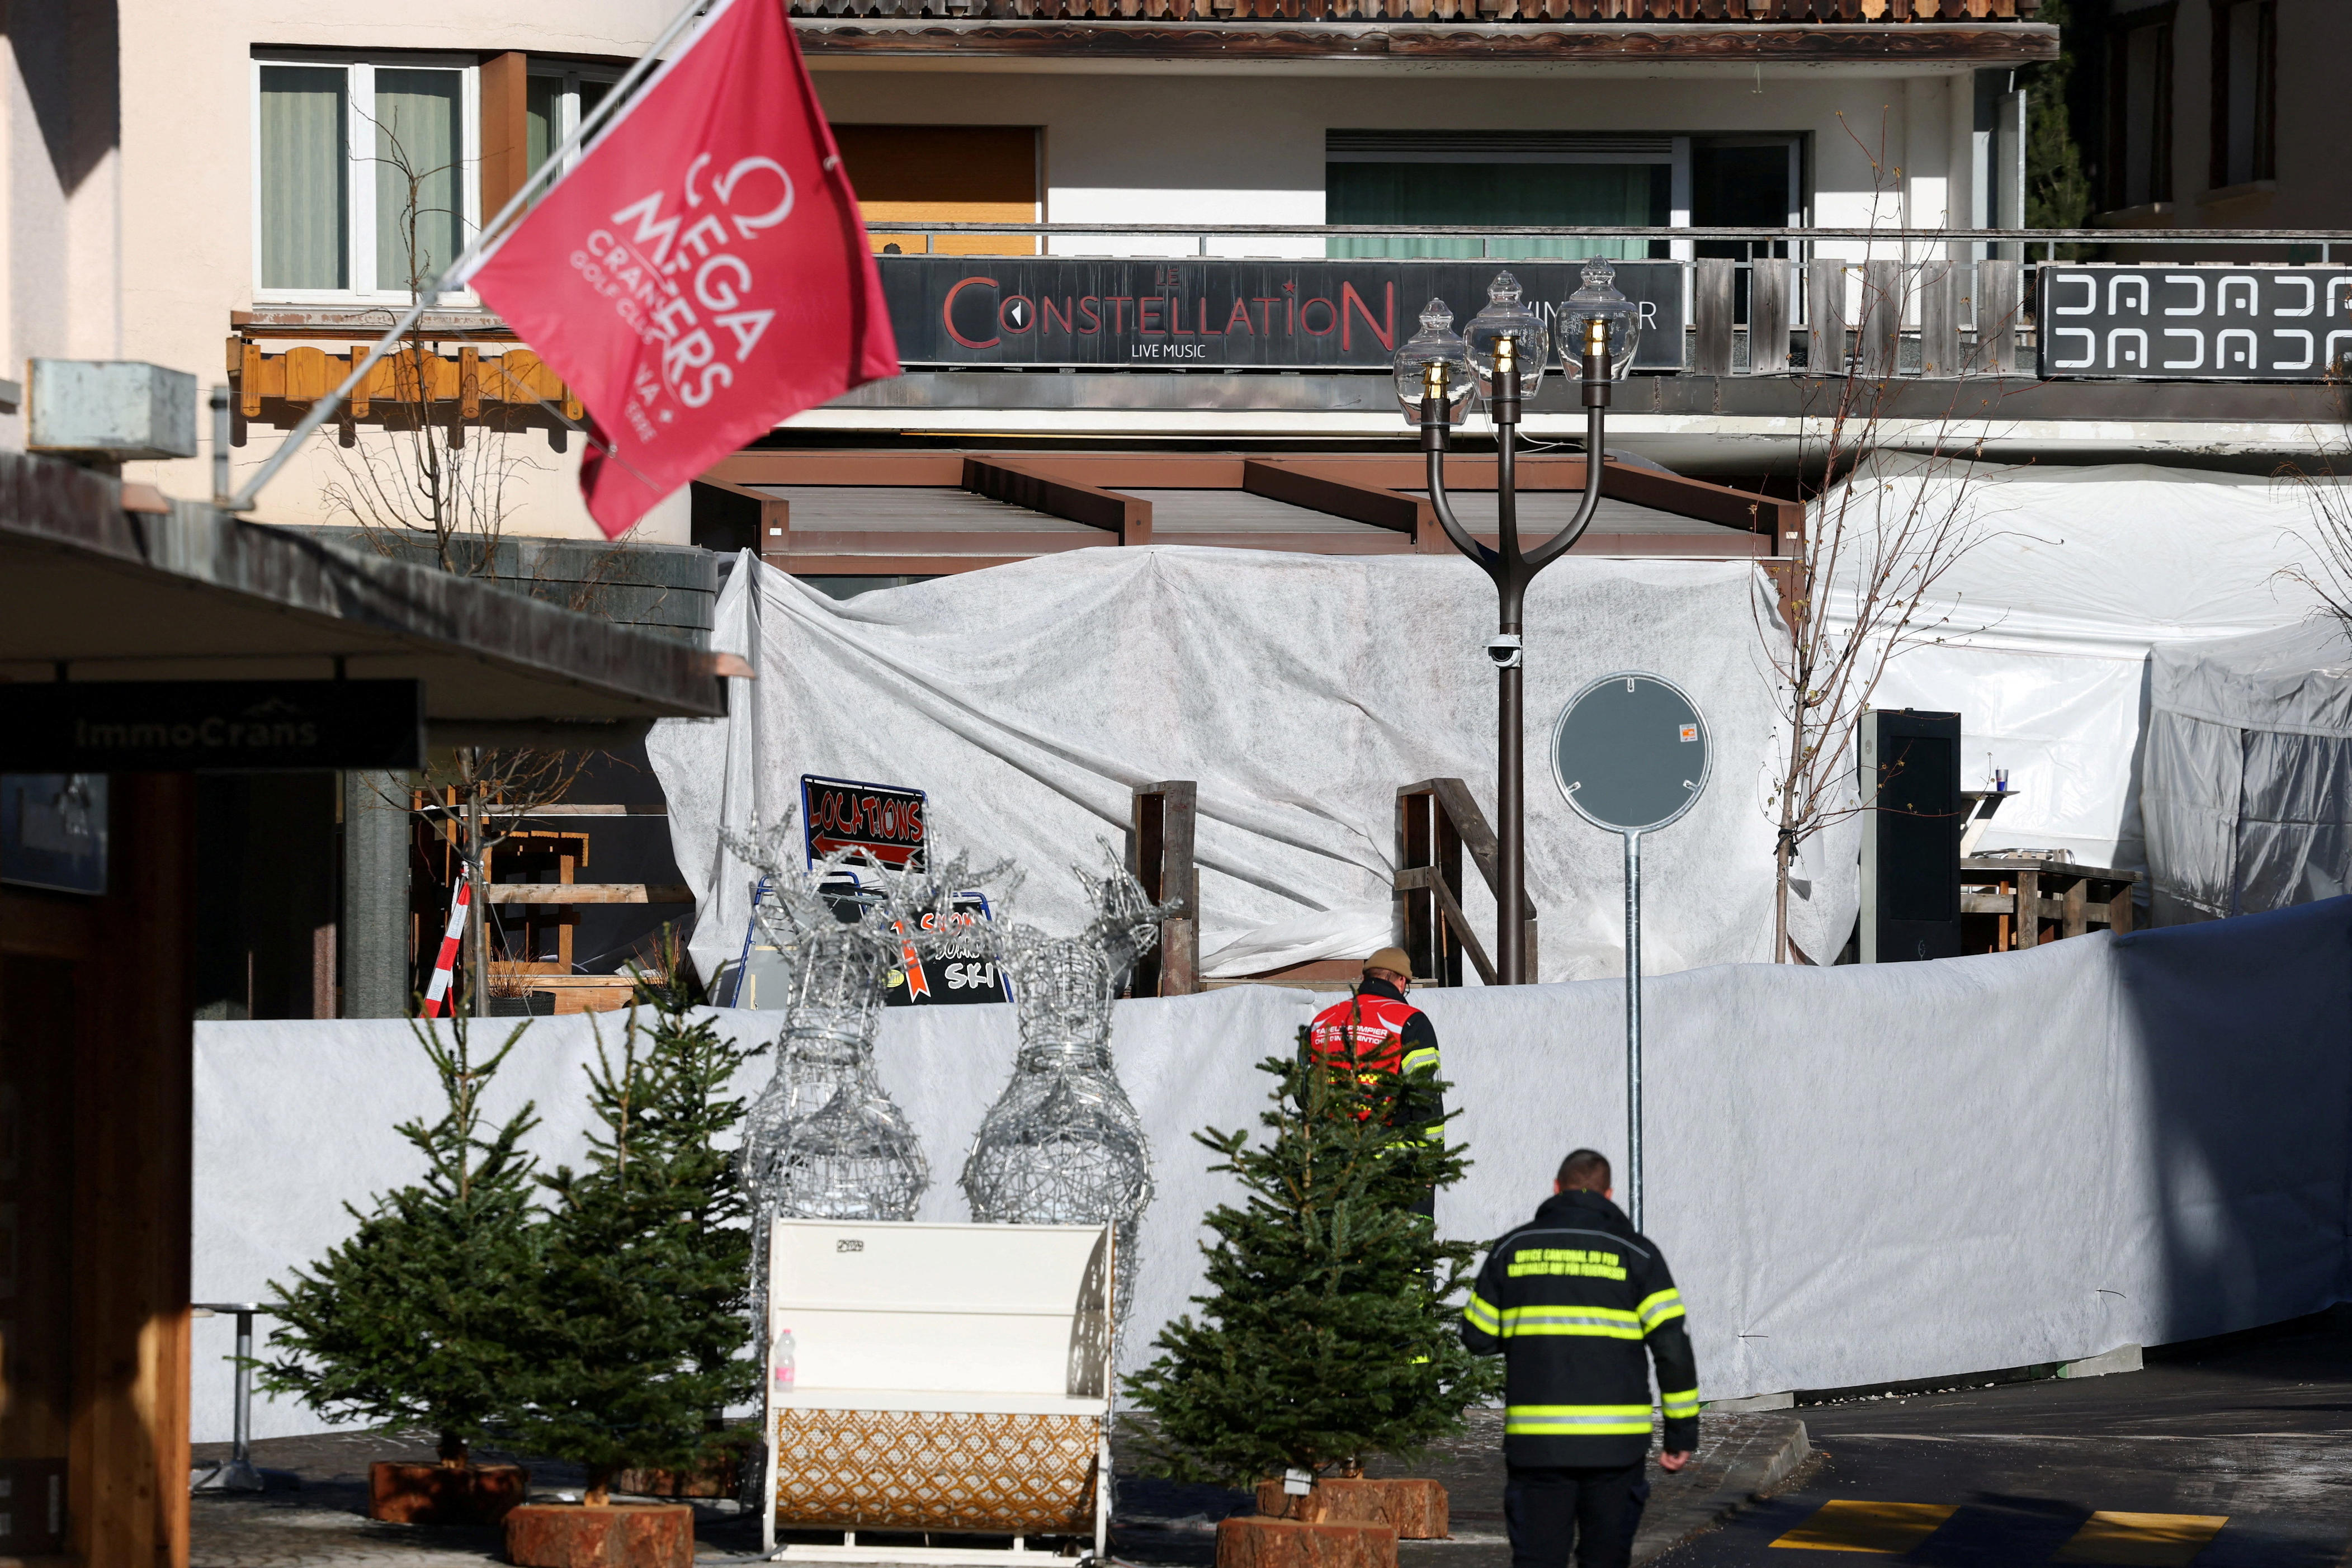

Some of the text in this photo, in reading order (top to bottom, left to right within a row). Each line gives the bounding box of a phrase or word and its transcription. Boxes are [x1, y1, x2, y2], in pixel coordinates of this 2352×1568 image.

[1156, 268, 1180, 286] LE
[1132, 344, 1206, 358] LIVE MUSIC
[74, 716, 318, 748] ImmoCrans
[808, 787, 924, 842] LOCATIONS
[944, 962, 994, 989] SKI
